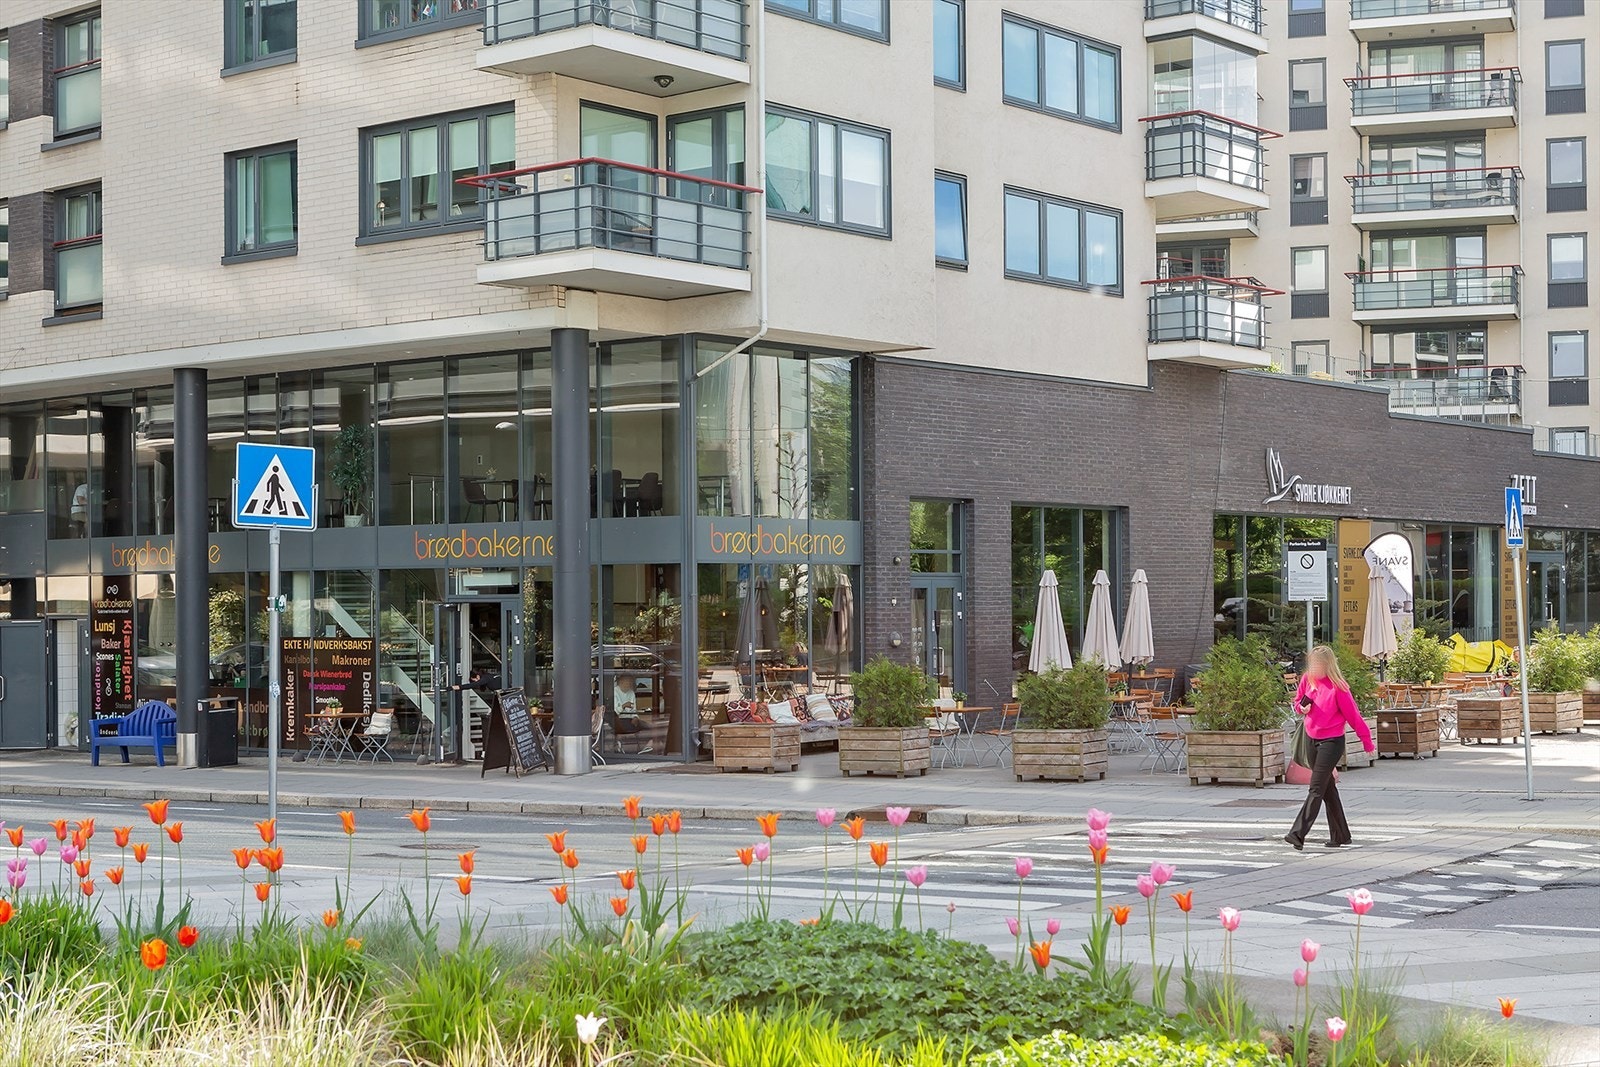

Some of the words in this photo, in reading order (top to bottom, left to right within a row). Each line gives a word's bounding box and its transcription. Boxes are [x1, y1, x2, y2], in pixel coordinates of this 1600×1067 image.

[1295, 483, 1317, 503] SVANE
[1317, 484, 1352, 504] KJØKKENET
[710, 522, 846, 556] brødbakerne
[94, 619, 116, 635] Lunsj
[101, 639, 122, 649] Baker
[283, 639, 302, 650] EKTE
[96, 652, 115, 661] Scones
[122, 620, 133, 700] Kjærlighet
[332, 655, 372, 666] Makroner
[114, 654, 122, 694] Salater
[286, 668, 295, 741] Kremkaker
